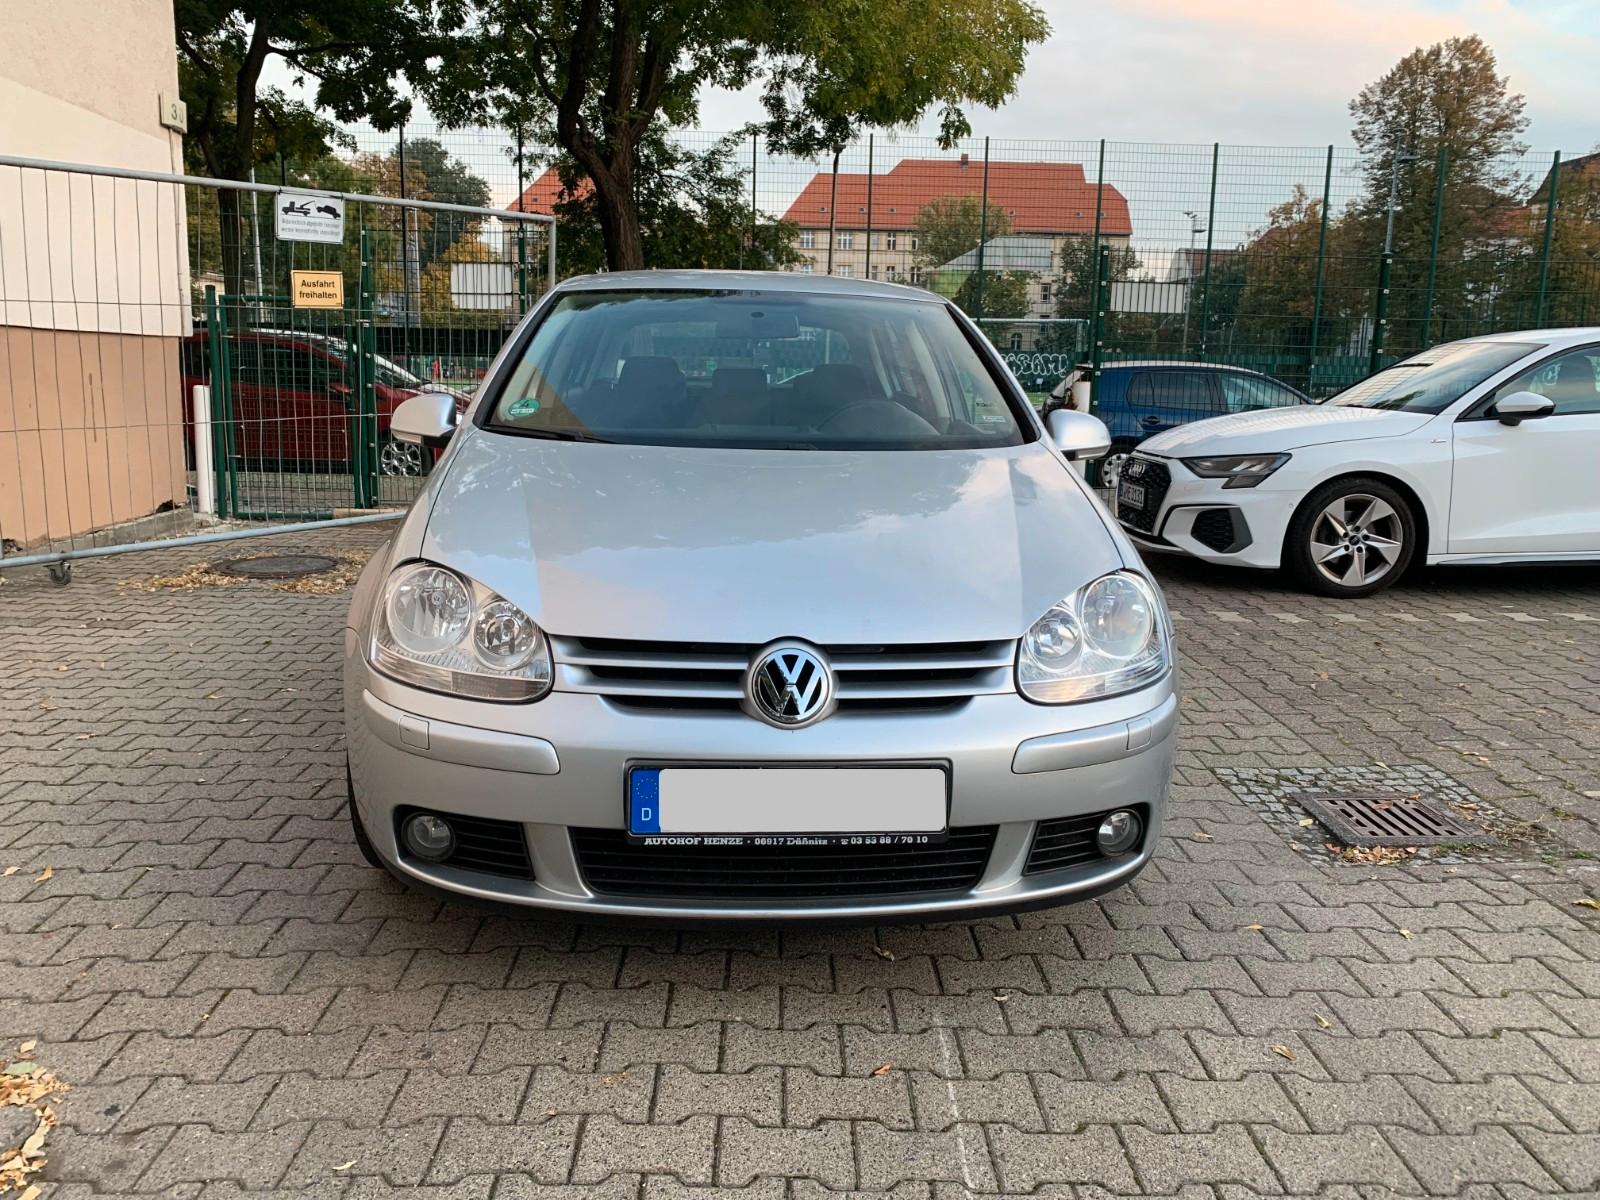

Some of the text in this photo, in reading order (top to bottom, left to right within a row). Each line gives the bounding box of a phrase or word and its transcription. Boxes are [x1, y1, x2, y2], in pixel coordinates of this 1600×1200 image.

[301, 279, 336, 288] Ausfahrt
[299, 290, 338, 299] freihalten
[641, 807, 652, 821] D
[644, 837, 702, 846] AUTOHOF
[703, 837, 744, 846] HENZE
[754, 837, 785, 846] 06917
[850, 836, 863, 845] 03
[865, 836, 877, 845] 53
[879, 836, 892, 845] 88
[901, 835, 913, 844] 70
[916, 835, 929, 844] 10
